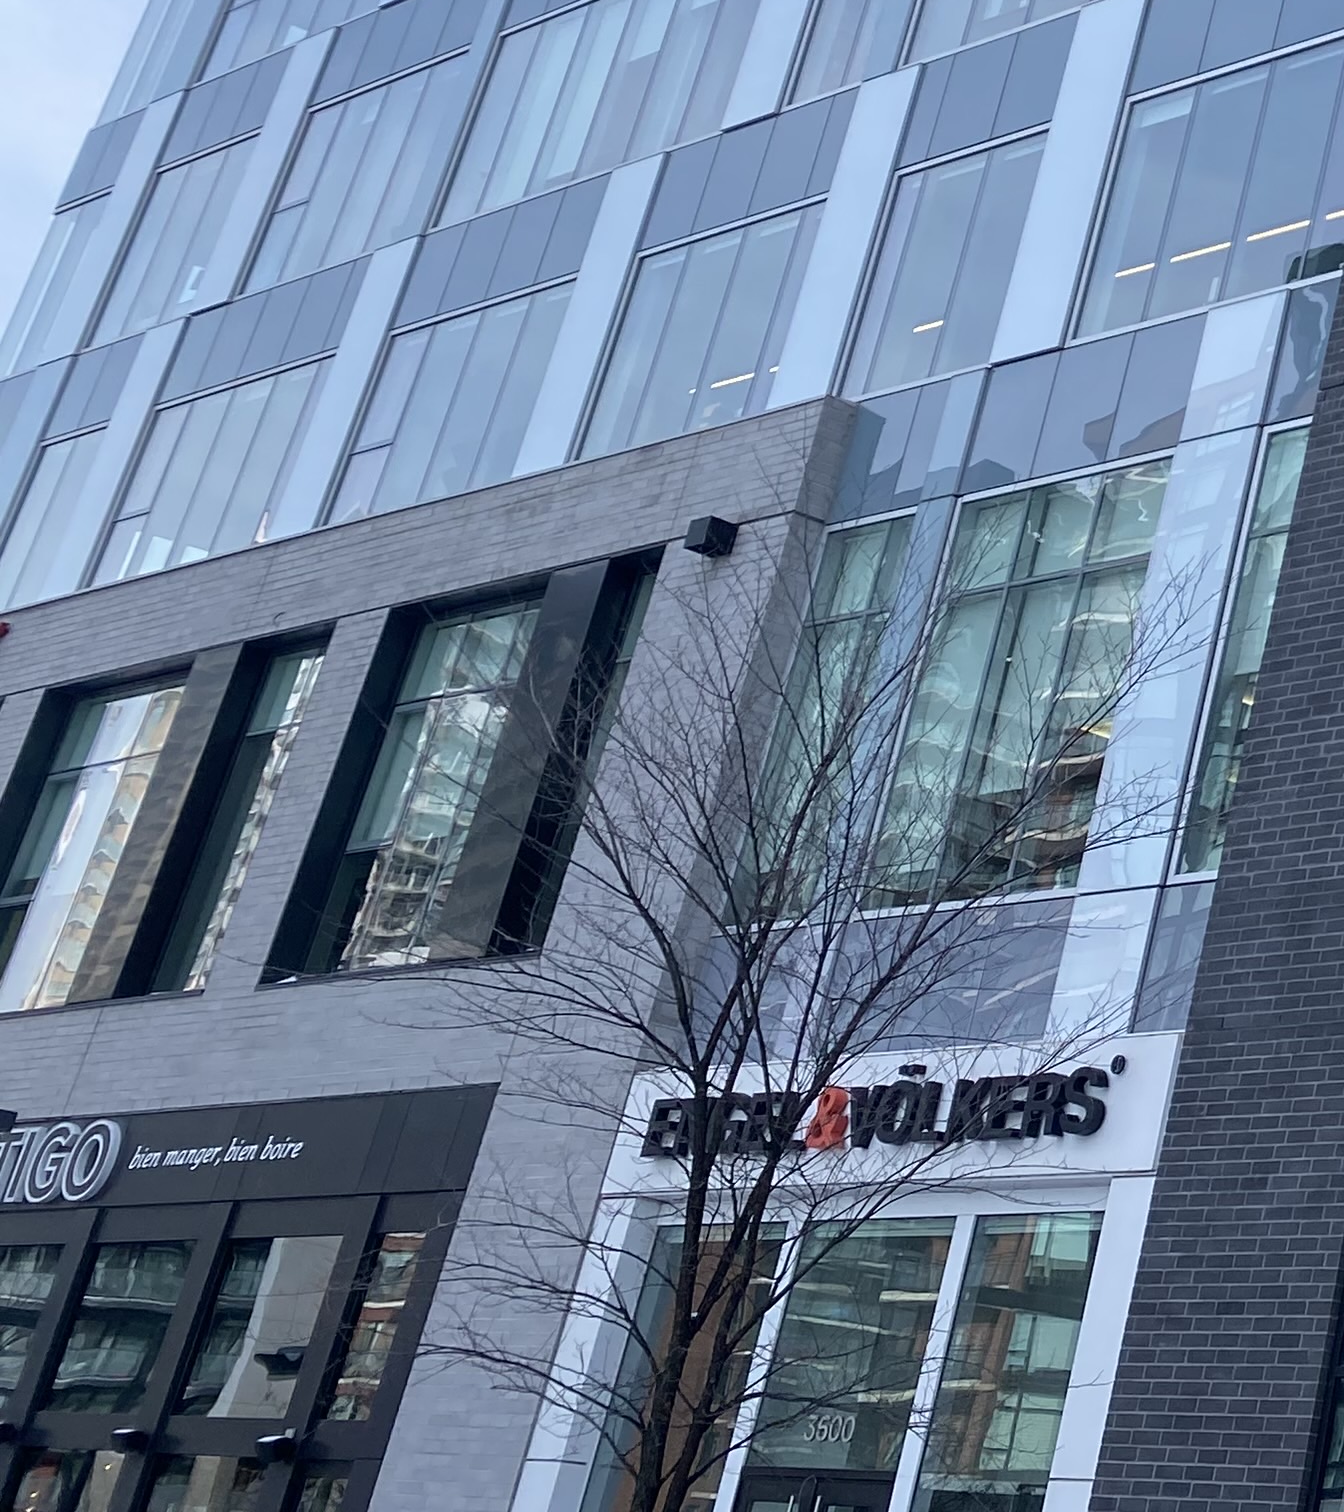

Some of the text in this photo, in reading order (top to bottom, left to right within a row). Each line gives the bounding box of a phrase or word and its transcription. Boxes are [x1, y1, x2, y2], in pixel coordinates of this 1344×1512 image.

[128, 1135, 304, 1170] bien manger, bien boire
